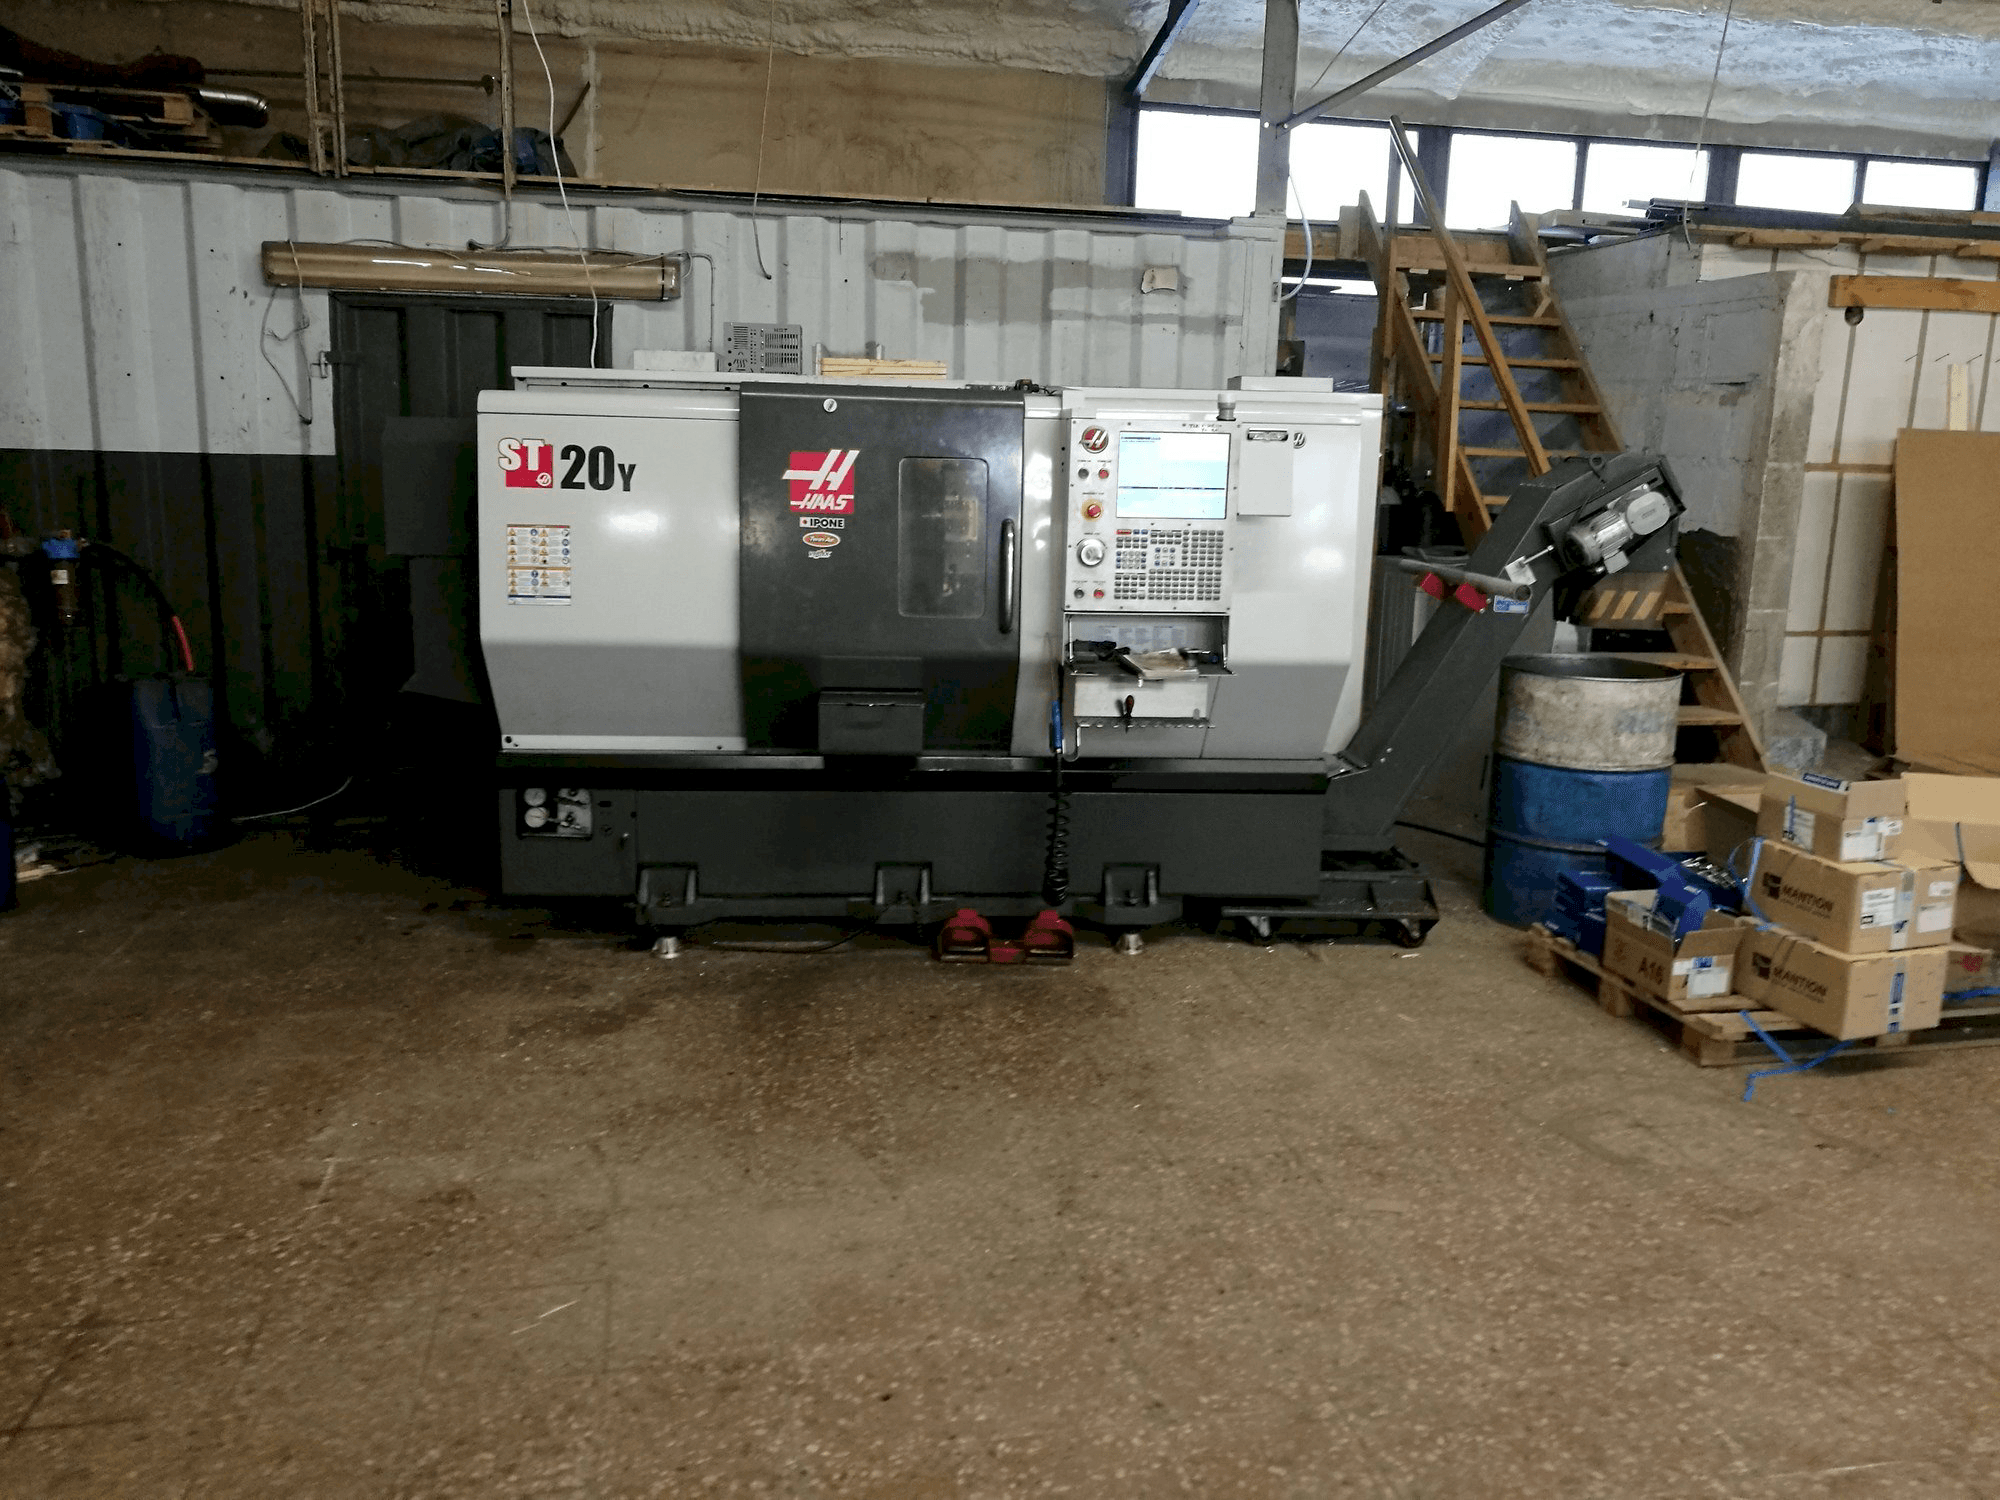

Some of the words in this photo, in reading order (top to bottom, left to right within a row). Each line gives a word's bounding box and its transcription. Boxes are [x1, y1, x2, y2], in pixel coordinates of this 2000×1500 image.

[498, 437, 545, 471] ST
[790, 493, 854, 511] HAAS
[810, 518, 843, 528] IPONE
[1782, 885, 1834, 912] MANTION
[1773, 966, 1829, 997] MANTION
